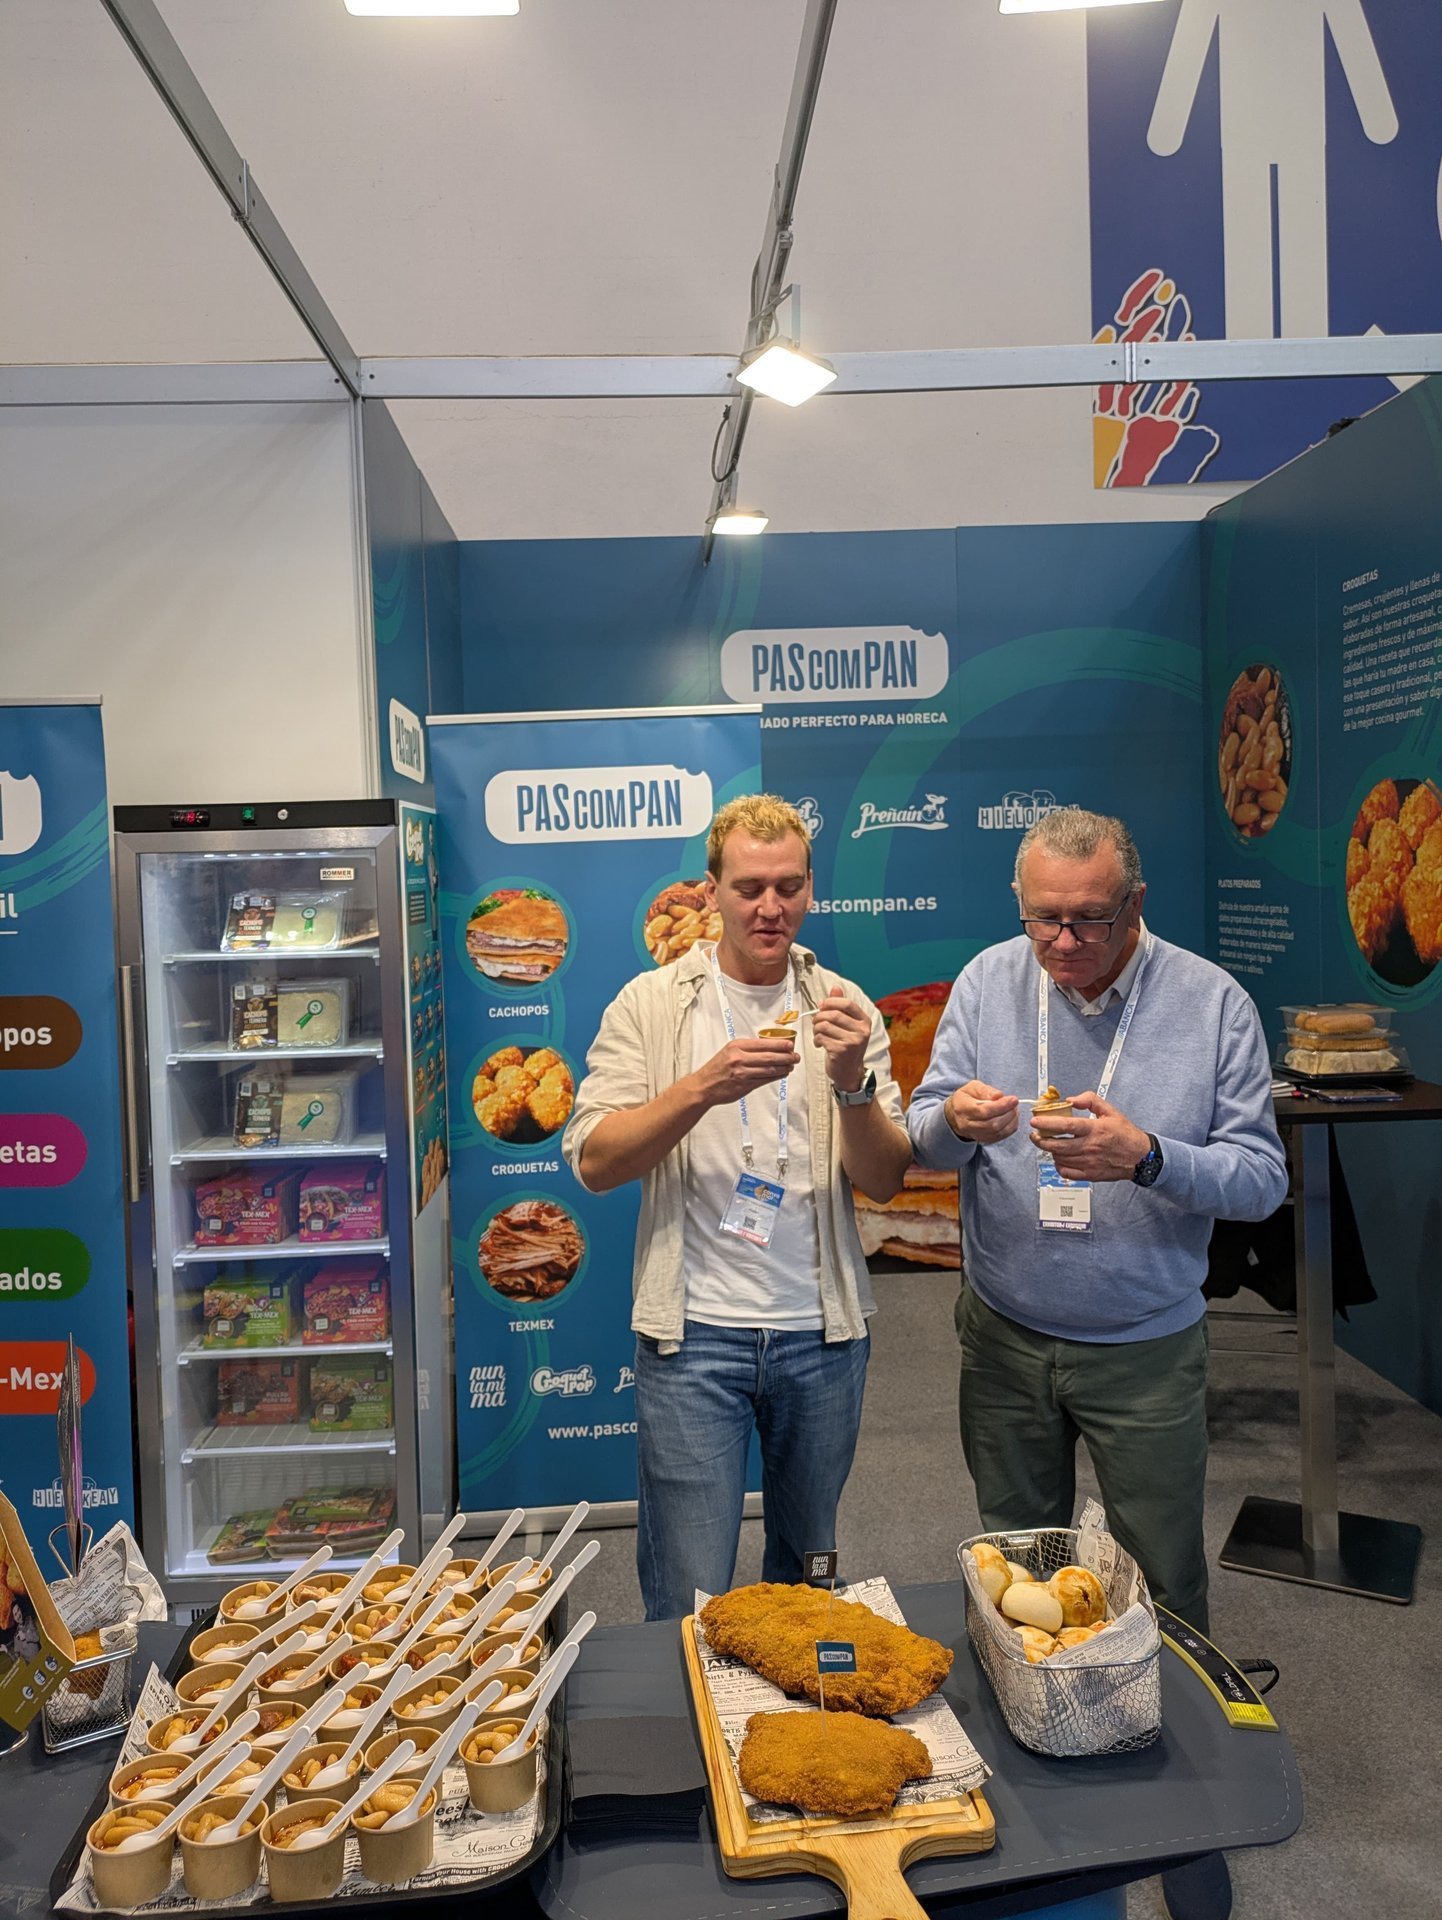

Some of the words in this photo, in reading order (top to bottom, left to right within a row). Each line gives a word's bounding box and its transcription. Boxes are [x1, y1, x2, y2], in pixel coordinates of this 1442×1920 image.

[1342, 568, 1379, 593] CROQUETAS
[1431, 571, 1441, 584] de
[1411, 588, 1442, 607] croqueta
[1408, 661, 1418, 671] en
[792, 715, 857, 728] PERFECTO
[860, 714, 895, 726] PARA
[897, 712, 948, 725] HORECA
[488, 1004, 550, 1019] CACHOPOS
[0, 1024, 52, 1052] pos
[491, 1160, 559, 1176] CROQUETAS
[508, 1319, 555, 1333] TEXMEX
[451, 1867, 471, 1875] House
